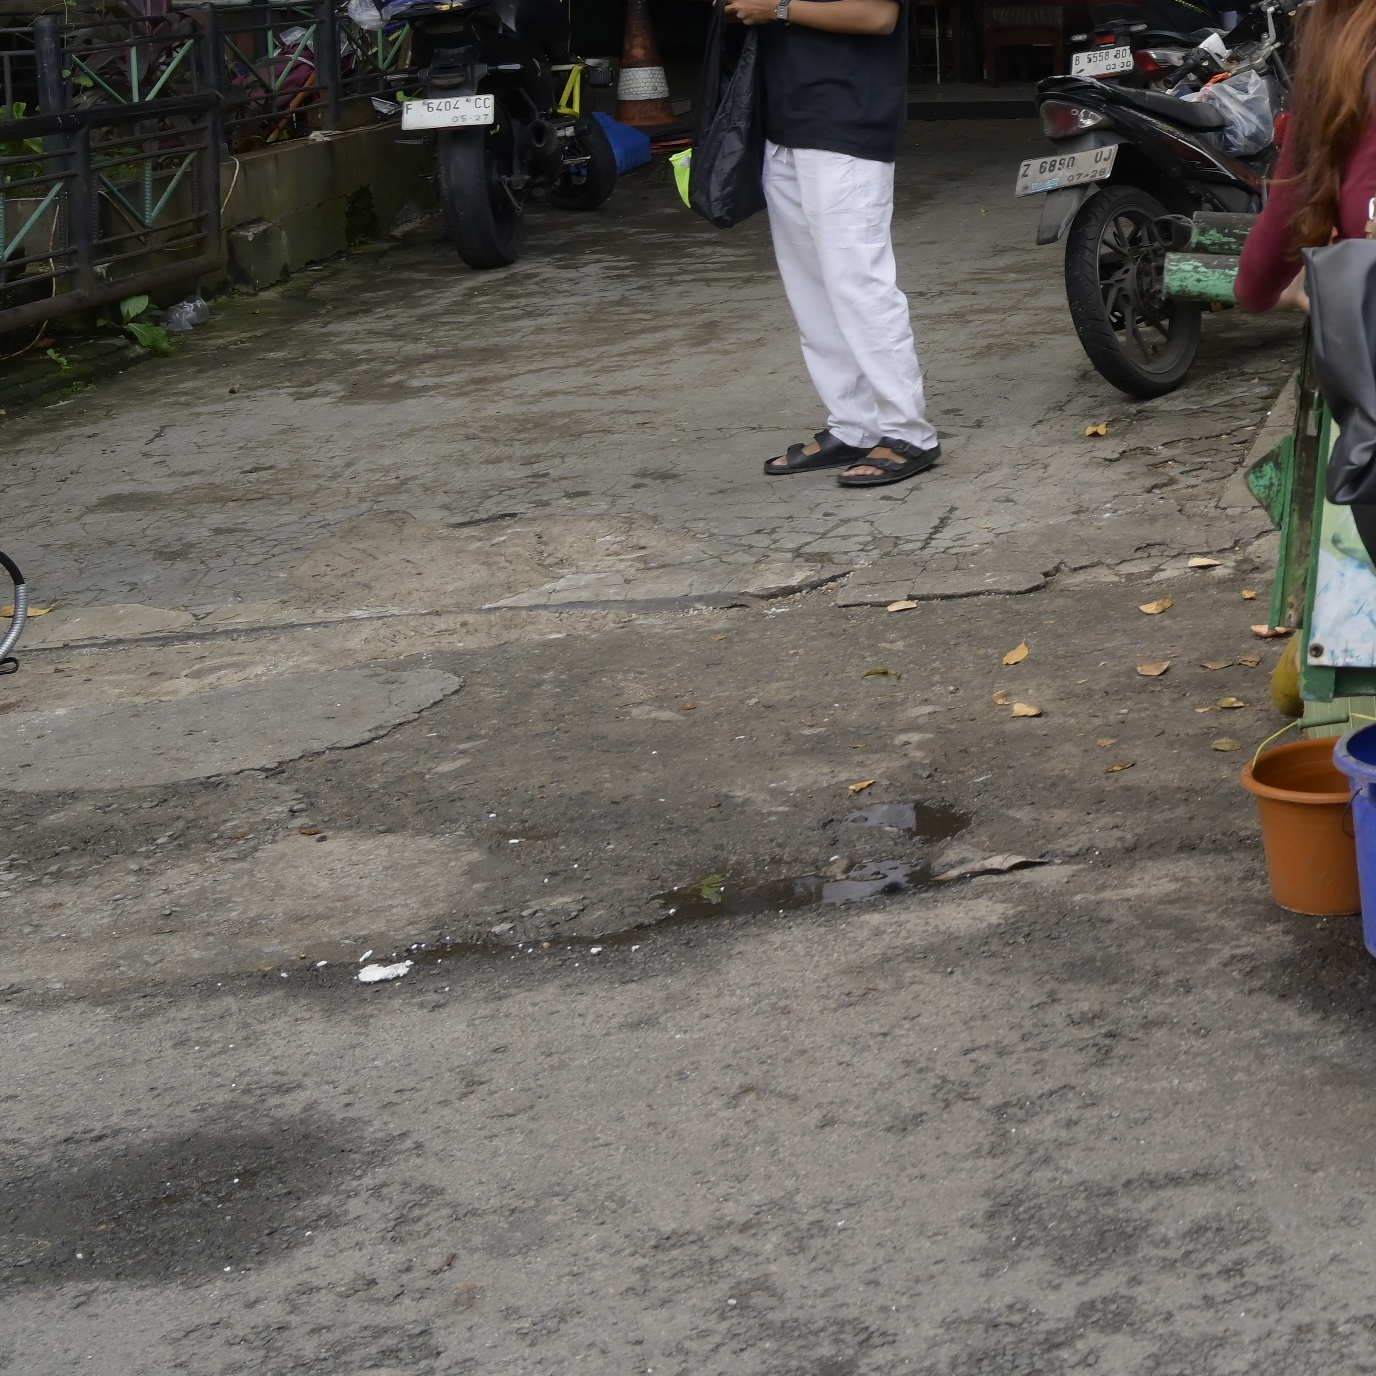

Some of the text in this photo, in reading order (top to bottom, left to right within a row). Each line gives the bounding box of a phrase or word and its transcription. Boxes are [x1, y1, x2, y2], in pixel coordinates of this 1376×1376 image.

[405, 97, 491, 115] F 6404 CC
[1021, 164, 1030, 178] Z
[1094, 148, 1113, 164] UJ
